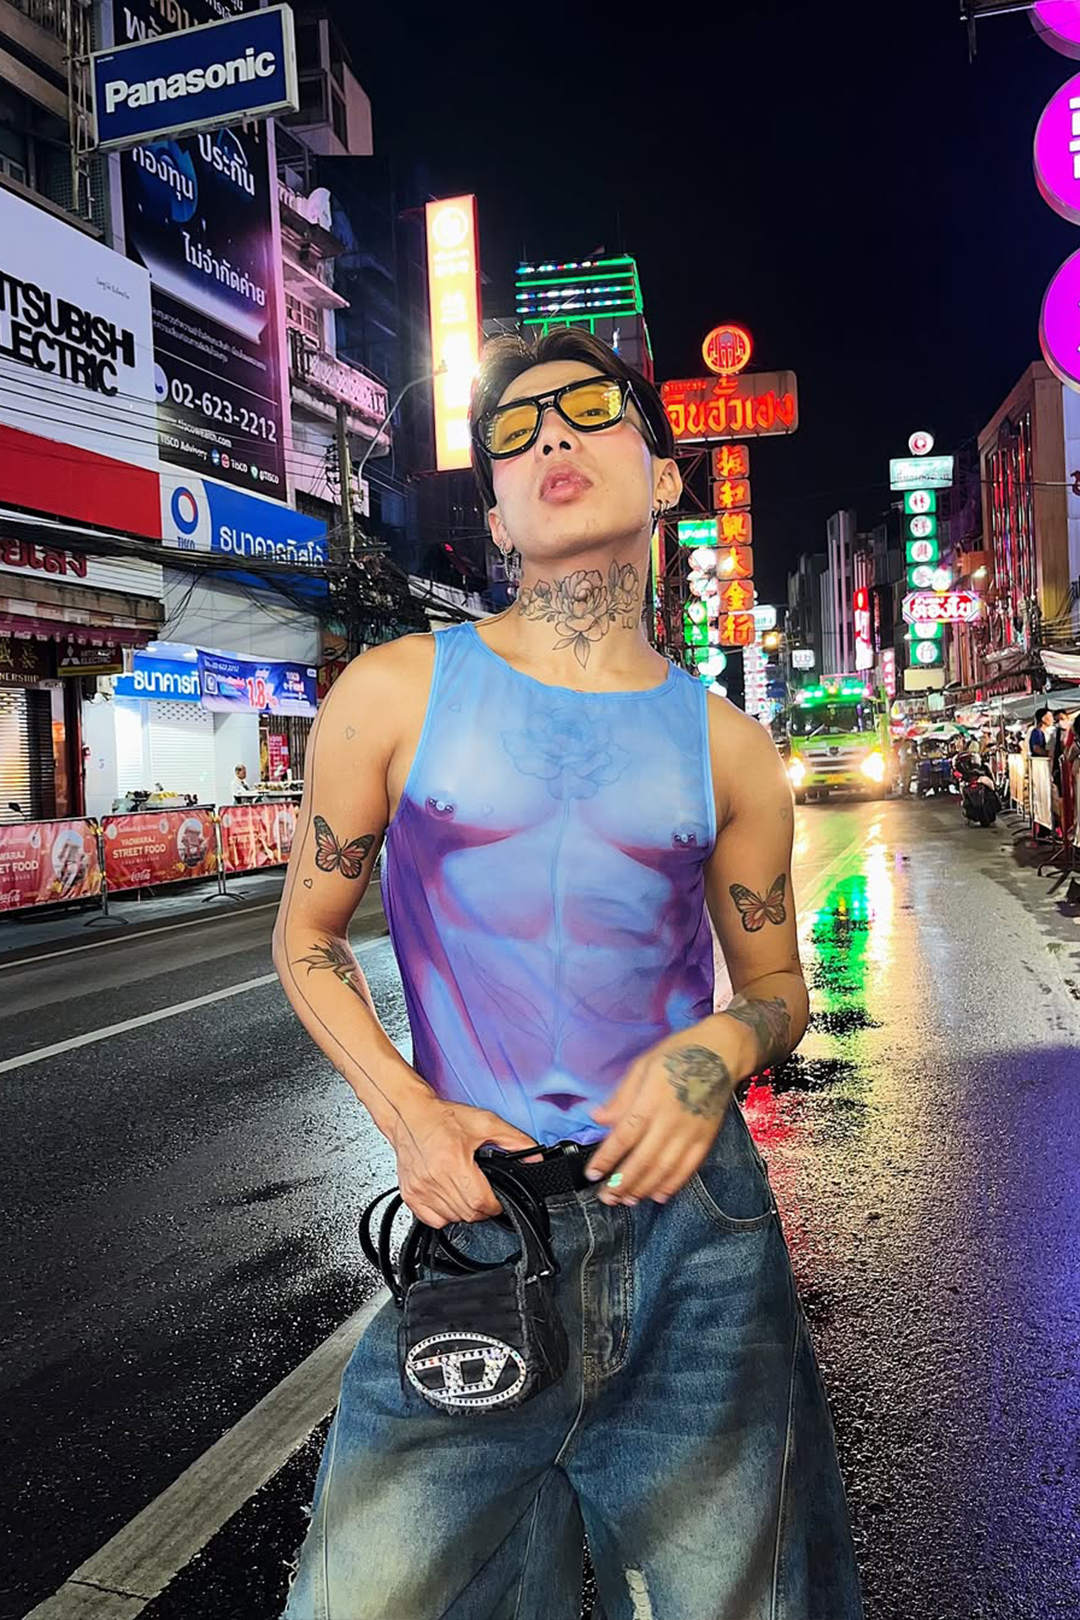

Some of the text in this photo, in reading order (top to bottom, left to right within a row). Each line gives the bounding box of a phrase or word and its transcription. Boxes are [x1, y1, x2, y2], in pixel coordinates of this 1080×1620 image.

[105, 47, 276, 114] Panasonic
[198, 133, 256, 197] ประกัน
[171, 379, 277, 443] 02-623-2212
[12, 859, 39, 873] FOOD
[112, 843, 166, 859] STREET FOOD
